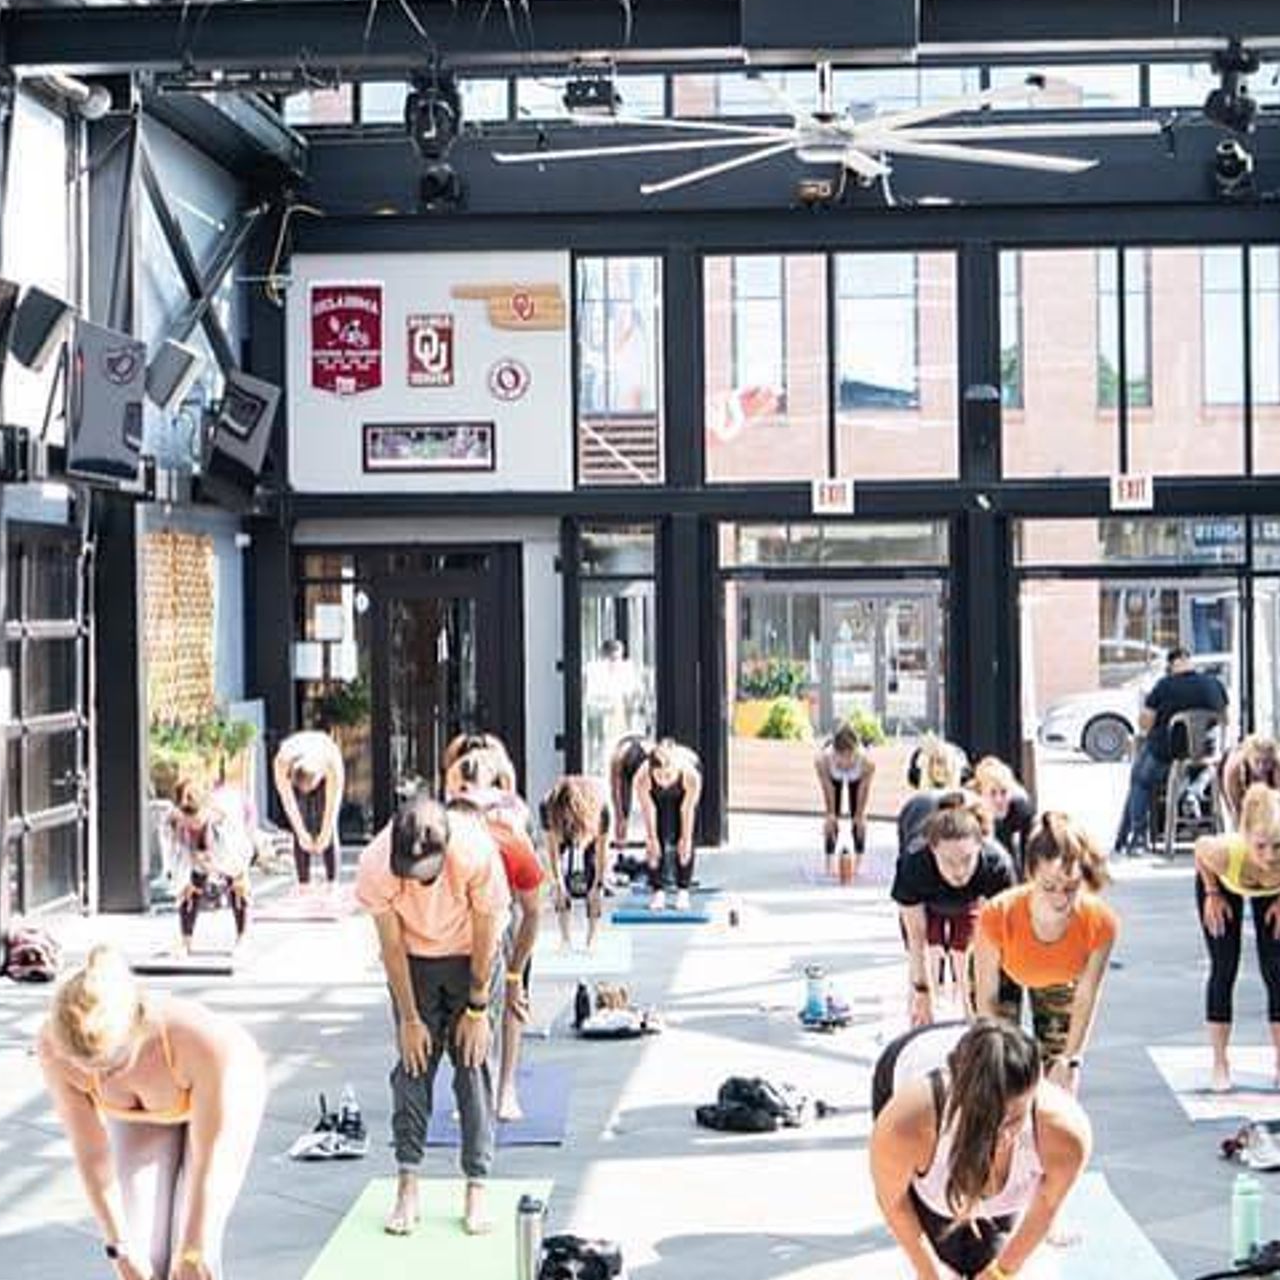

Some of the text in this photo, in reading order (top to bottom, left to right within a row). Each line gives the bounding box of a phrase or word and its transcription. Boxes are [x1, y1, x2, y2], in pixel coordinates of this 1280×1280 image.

[512, 293, 535, 321] OU
[414, 329, 447, 371] OU
[819, 483, 846, 505] EXIT
[1118, 479, 1145, 500] EXIT
